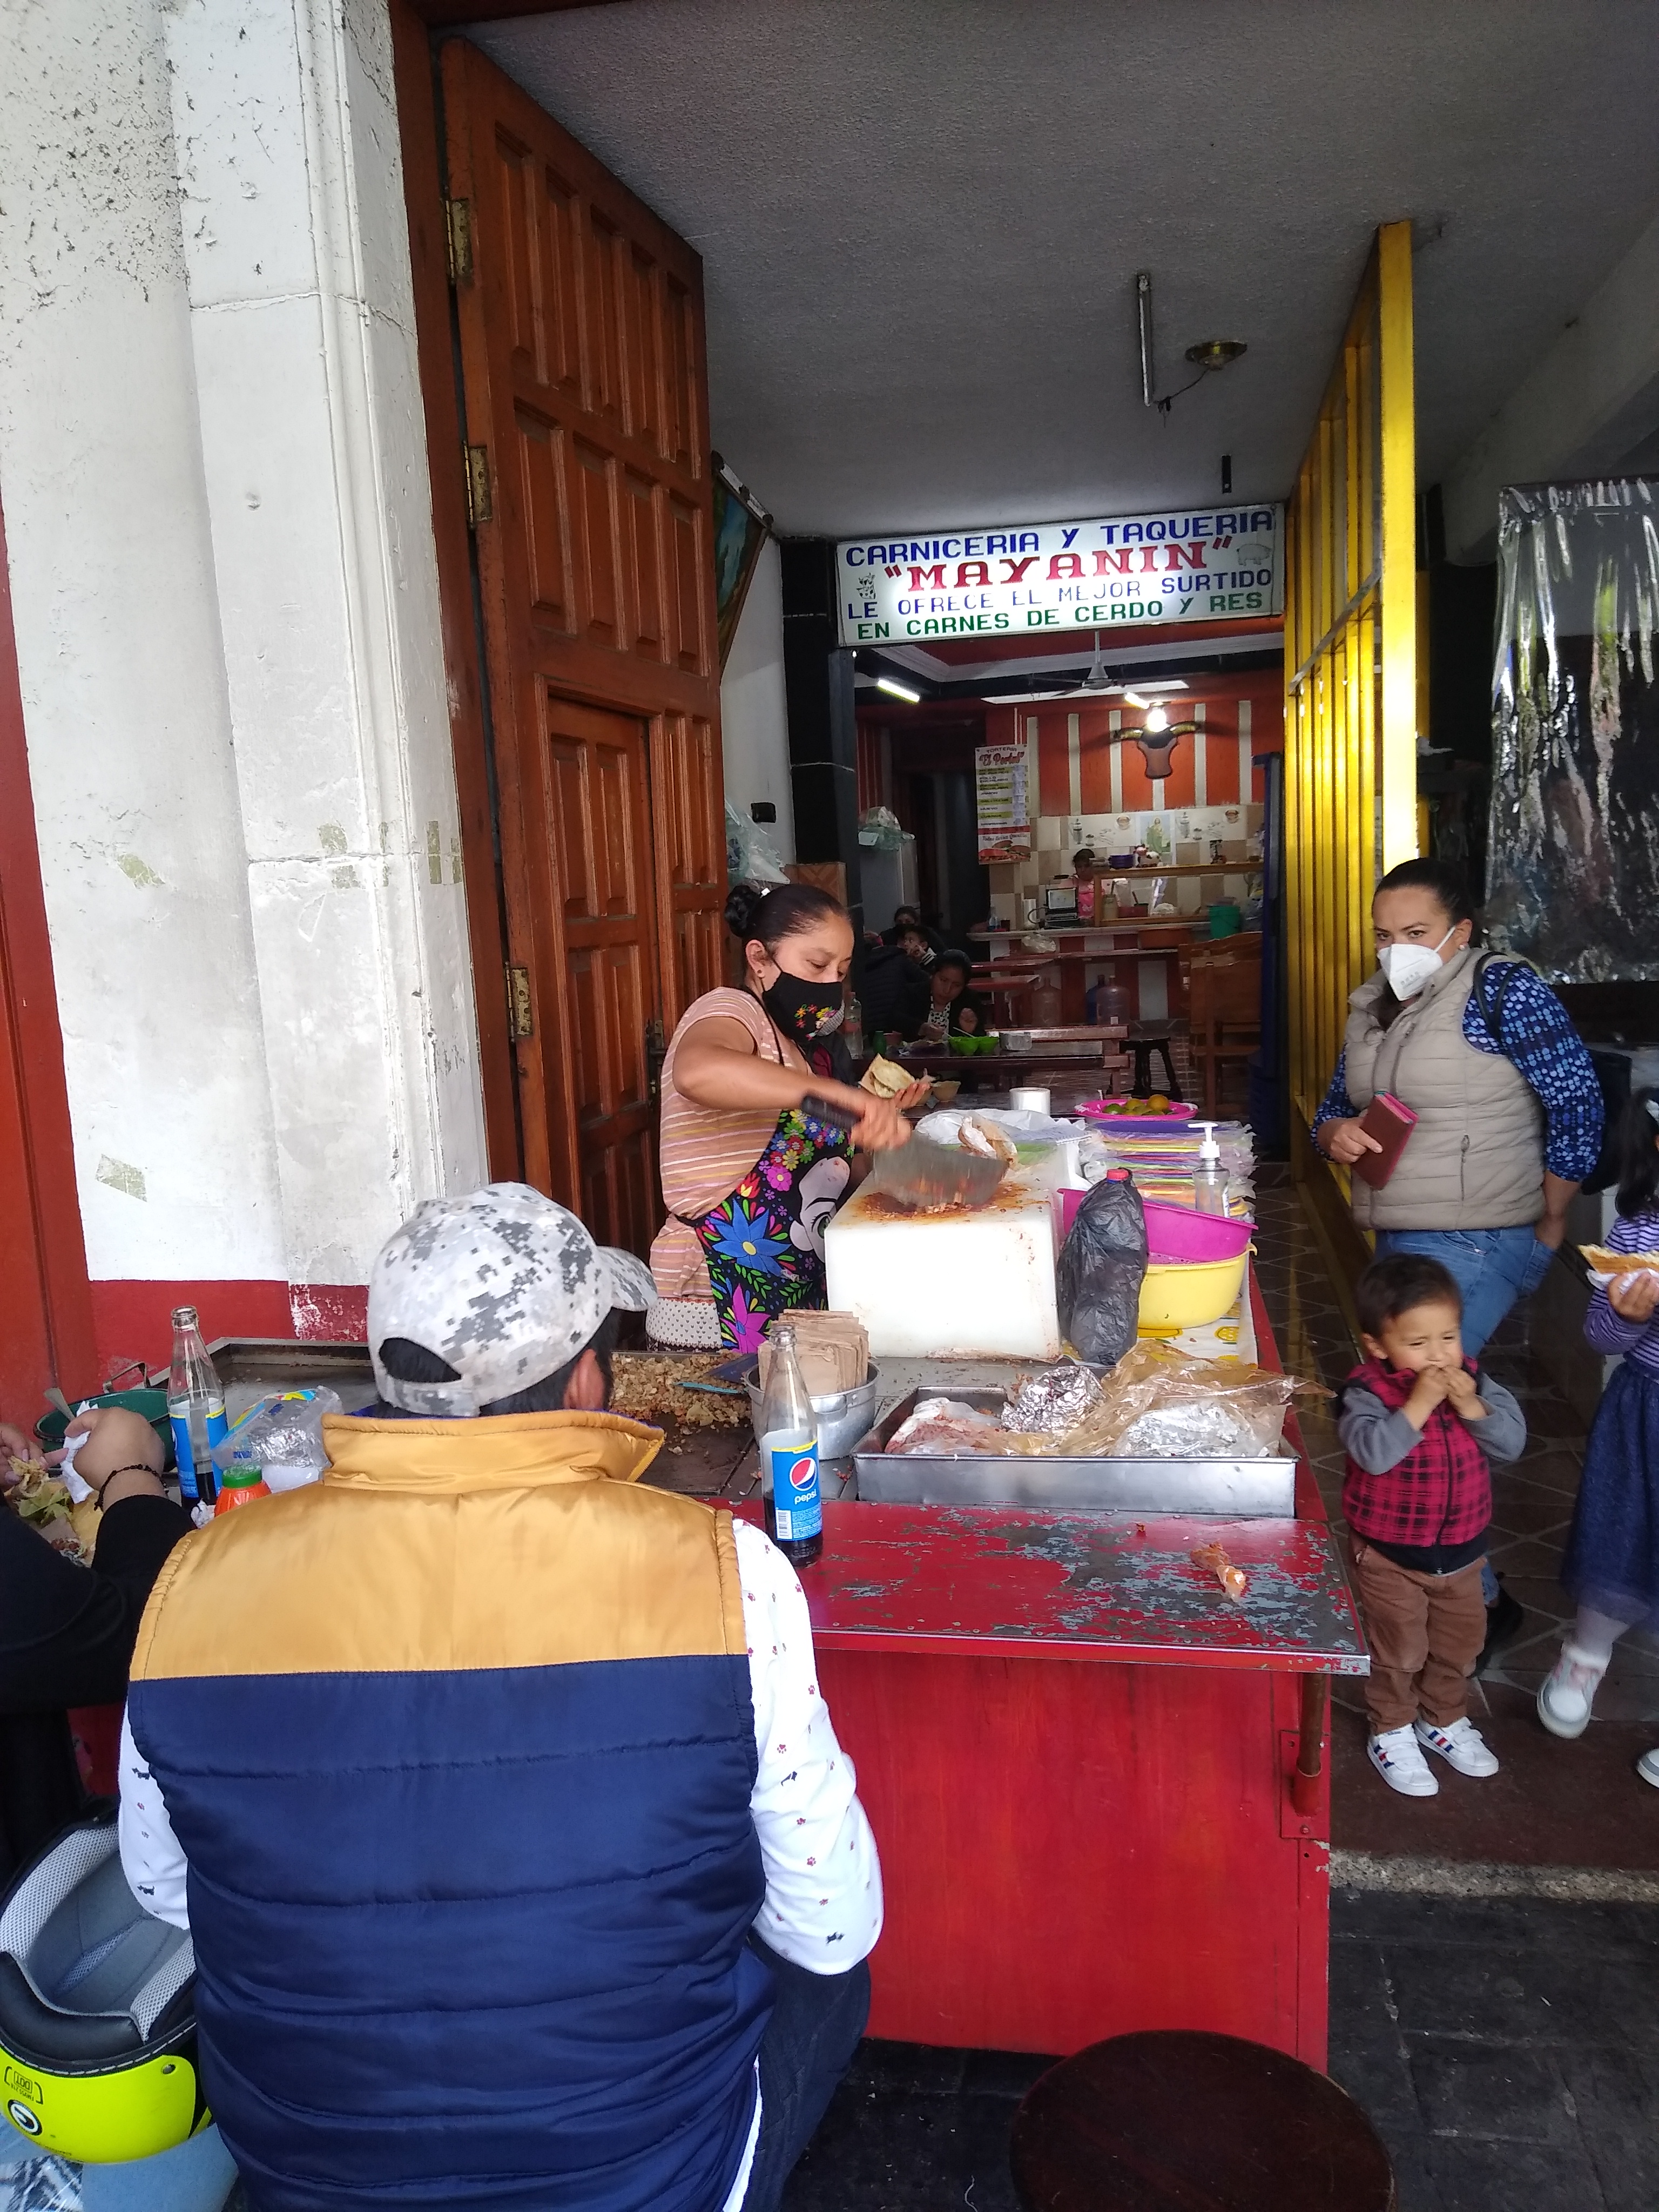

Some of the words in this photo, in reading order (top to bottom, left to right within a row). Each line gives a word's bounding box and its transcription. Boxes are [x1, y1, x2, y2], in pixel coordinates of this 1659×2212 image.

[846, 532, 1040, 567] CARNICERIA
[1061, 528, 1080, 549] Y
[1100, 510, 1273, 545] TAQUERIA
[884, 536, 1232, 592] "MAYANIN"
[848, 602, 879, 619] LE
[898, 593, 994, 615] OFRECE
[1013, 590, 1042, 606] EL
[1058, 581, 1141, 602] MEJOR
[1161, 569, 1271, 594] SURTIDO
[858, 622, 889, 640] EN
[907, 613, 1009, 636] CARNES
[1027, 609, 1060, 626] DE
[1075, 601, 1163, 623] CERDO
[1179, 597, 1193, 615] Y
[1210, 592, 1263, 612] RES
[794, 1489, 817, 1505] pepsi
[16, 2075, 30, 2090] DOT
